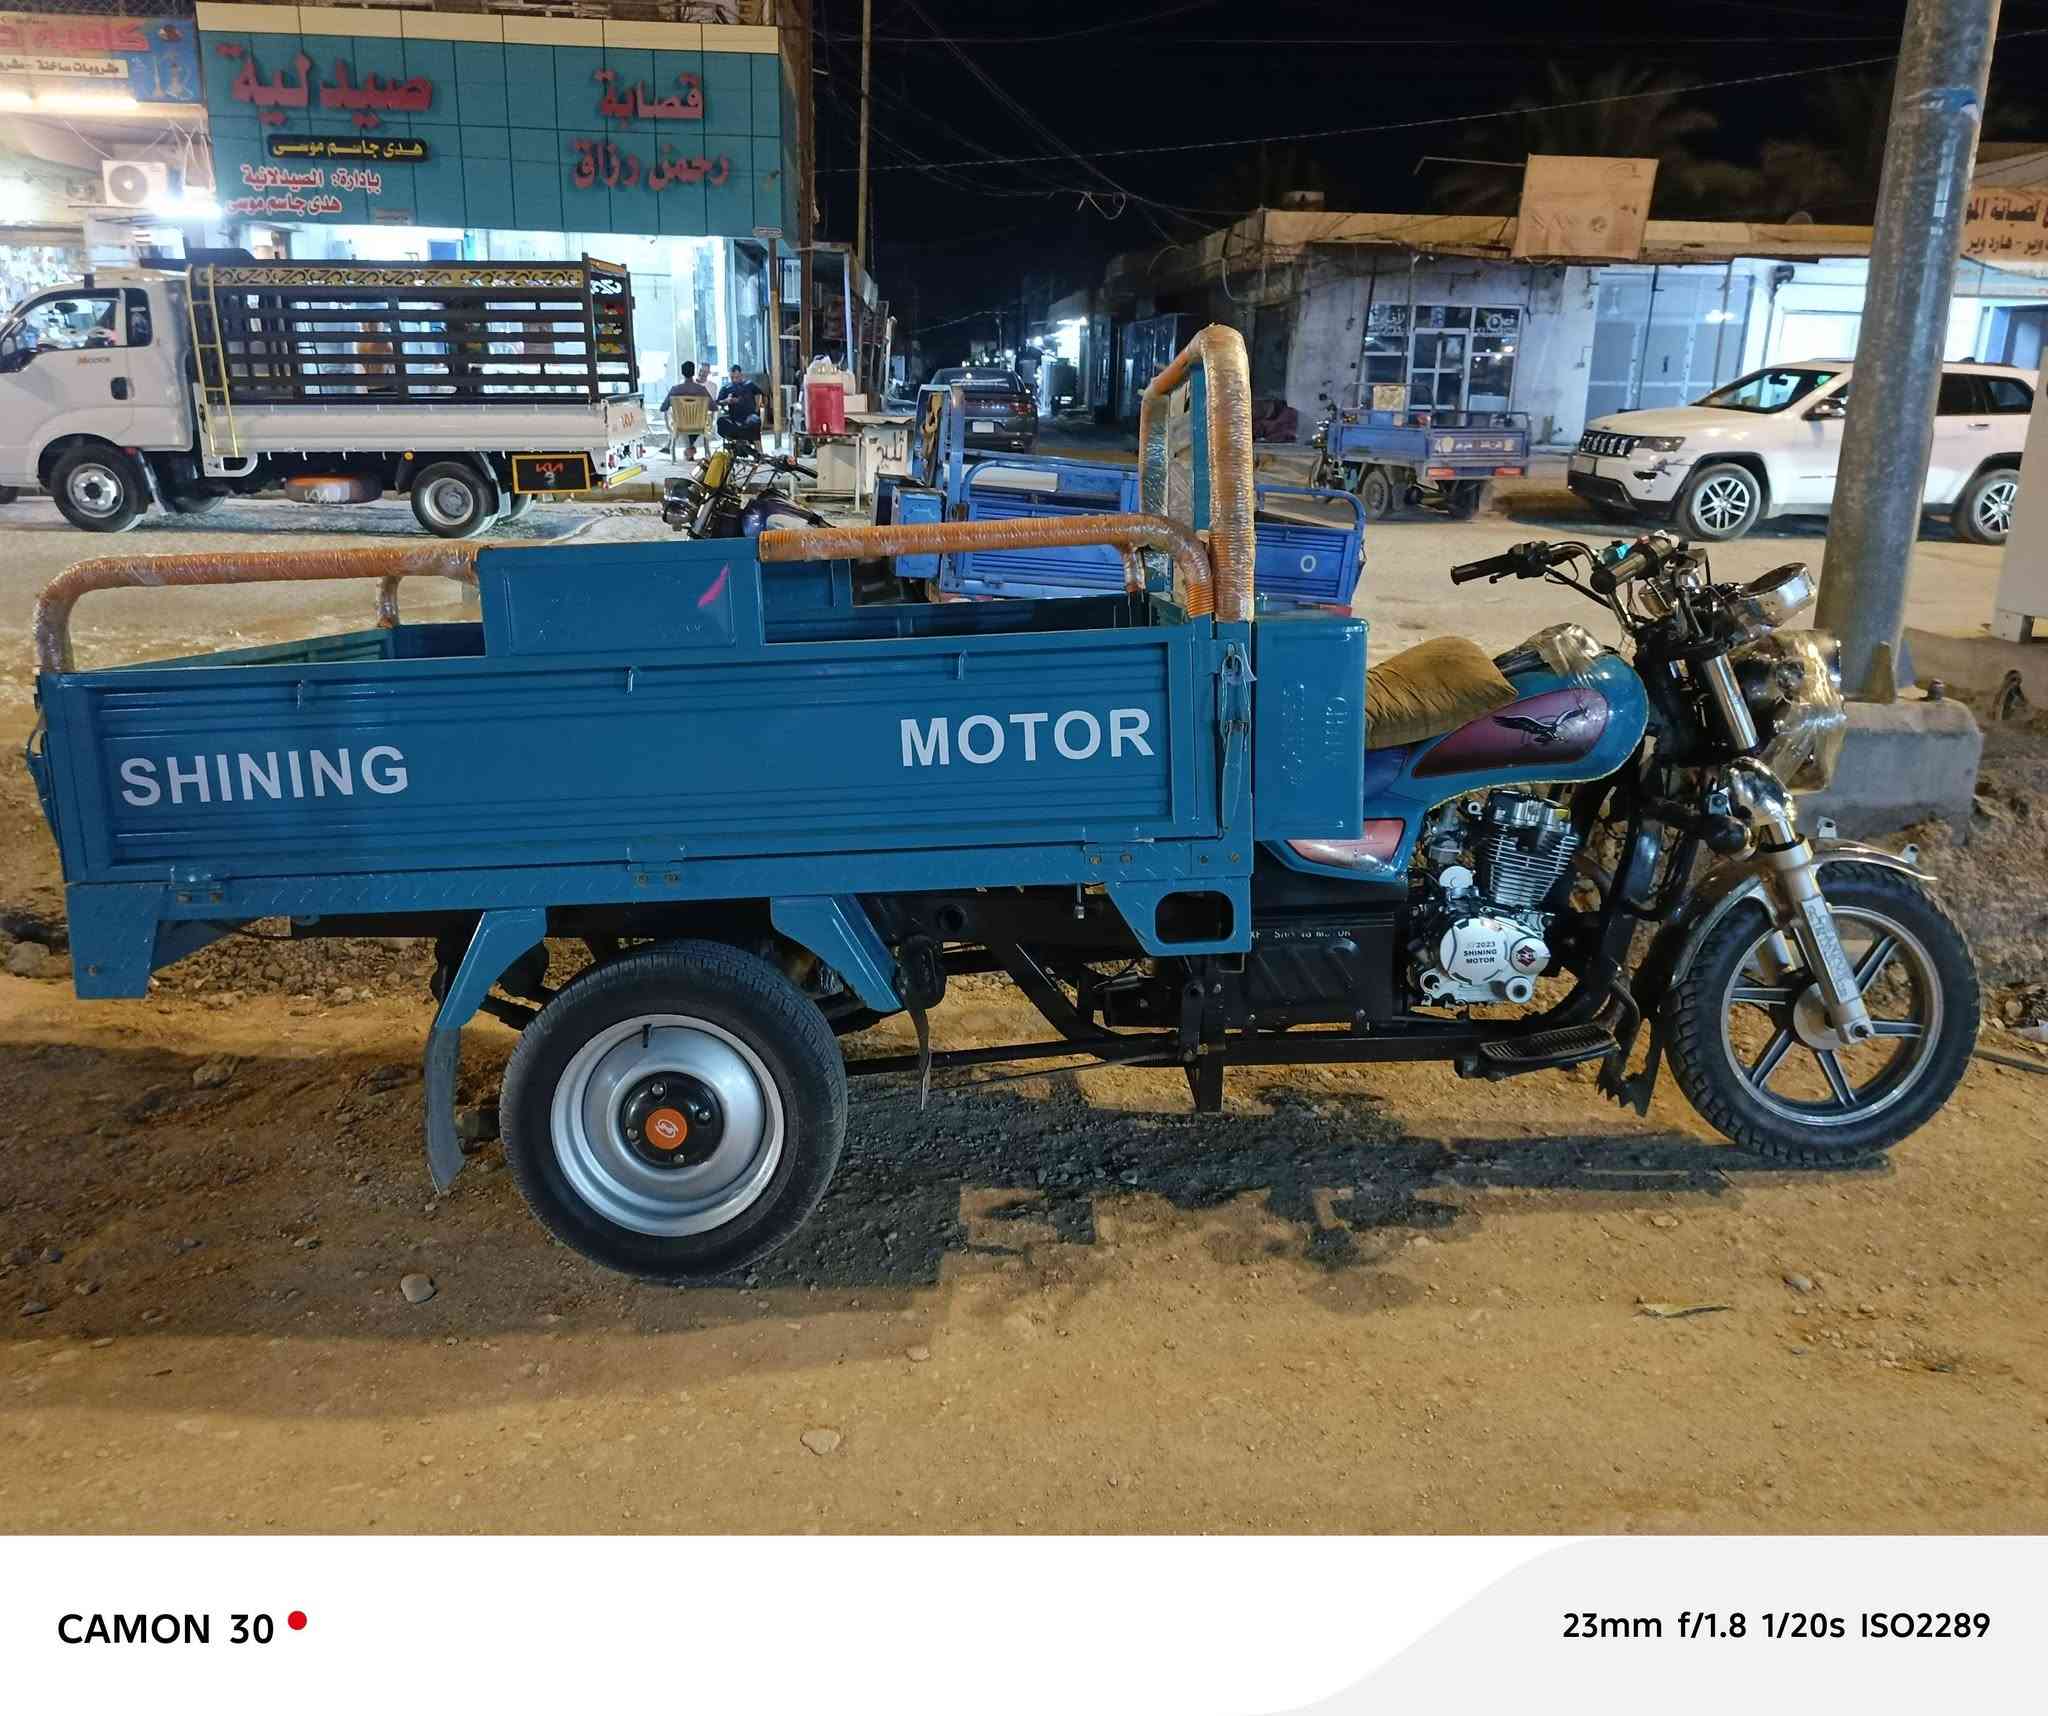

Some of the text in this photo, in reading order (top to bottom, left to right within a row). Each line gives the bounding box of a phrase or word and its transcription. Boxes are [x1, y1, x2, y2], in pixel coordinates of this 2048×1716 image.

[214, 42, 433, 128] صيدلية
[593, 68, 704, 129] قصابة
[272, 139, 424, 158] هدى جاسم موسى
[572, 138, 640, 189] رزاق
[267, 193, 307, 216] جاسم
[308, 195, 343, 215] هدى
[119, 708, 1155, 807] SHINING MOTOR
[1463, 949, 1497, 957] SHINING
